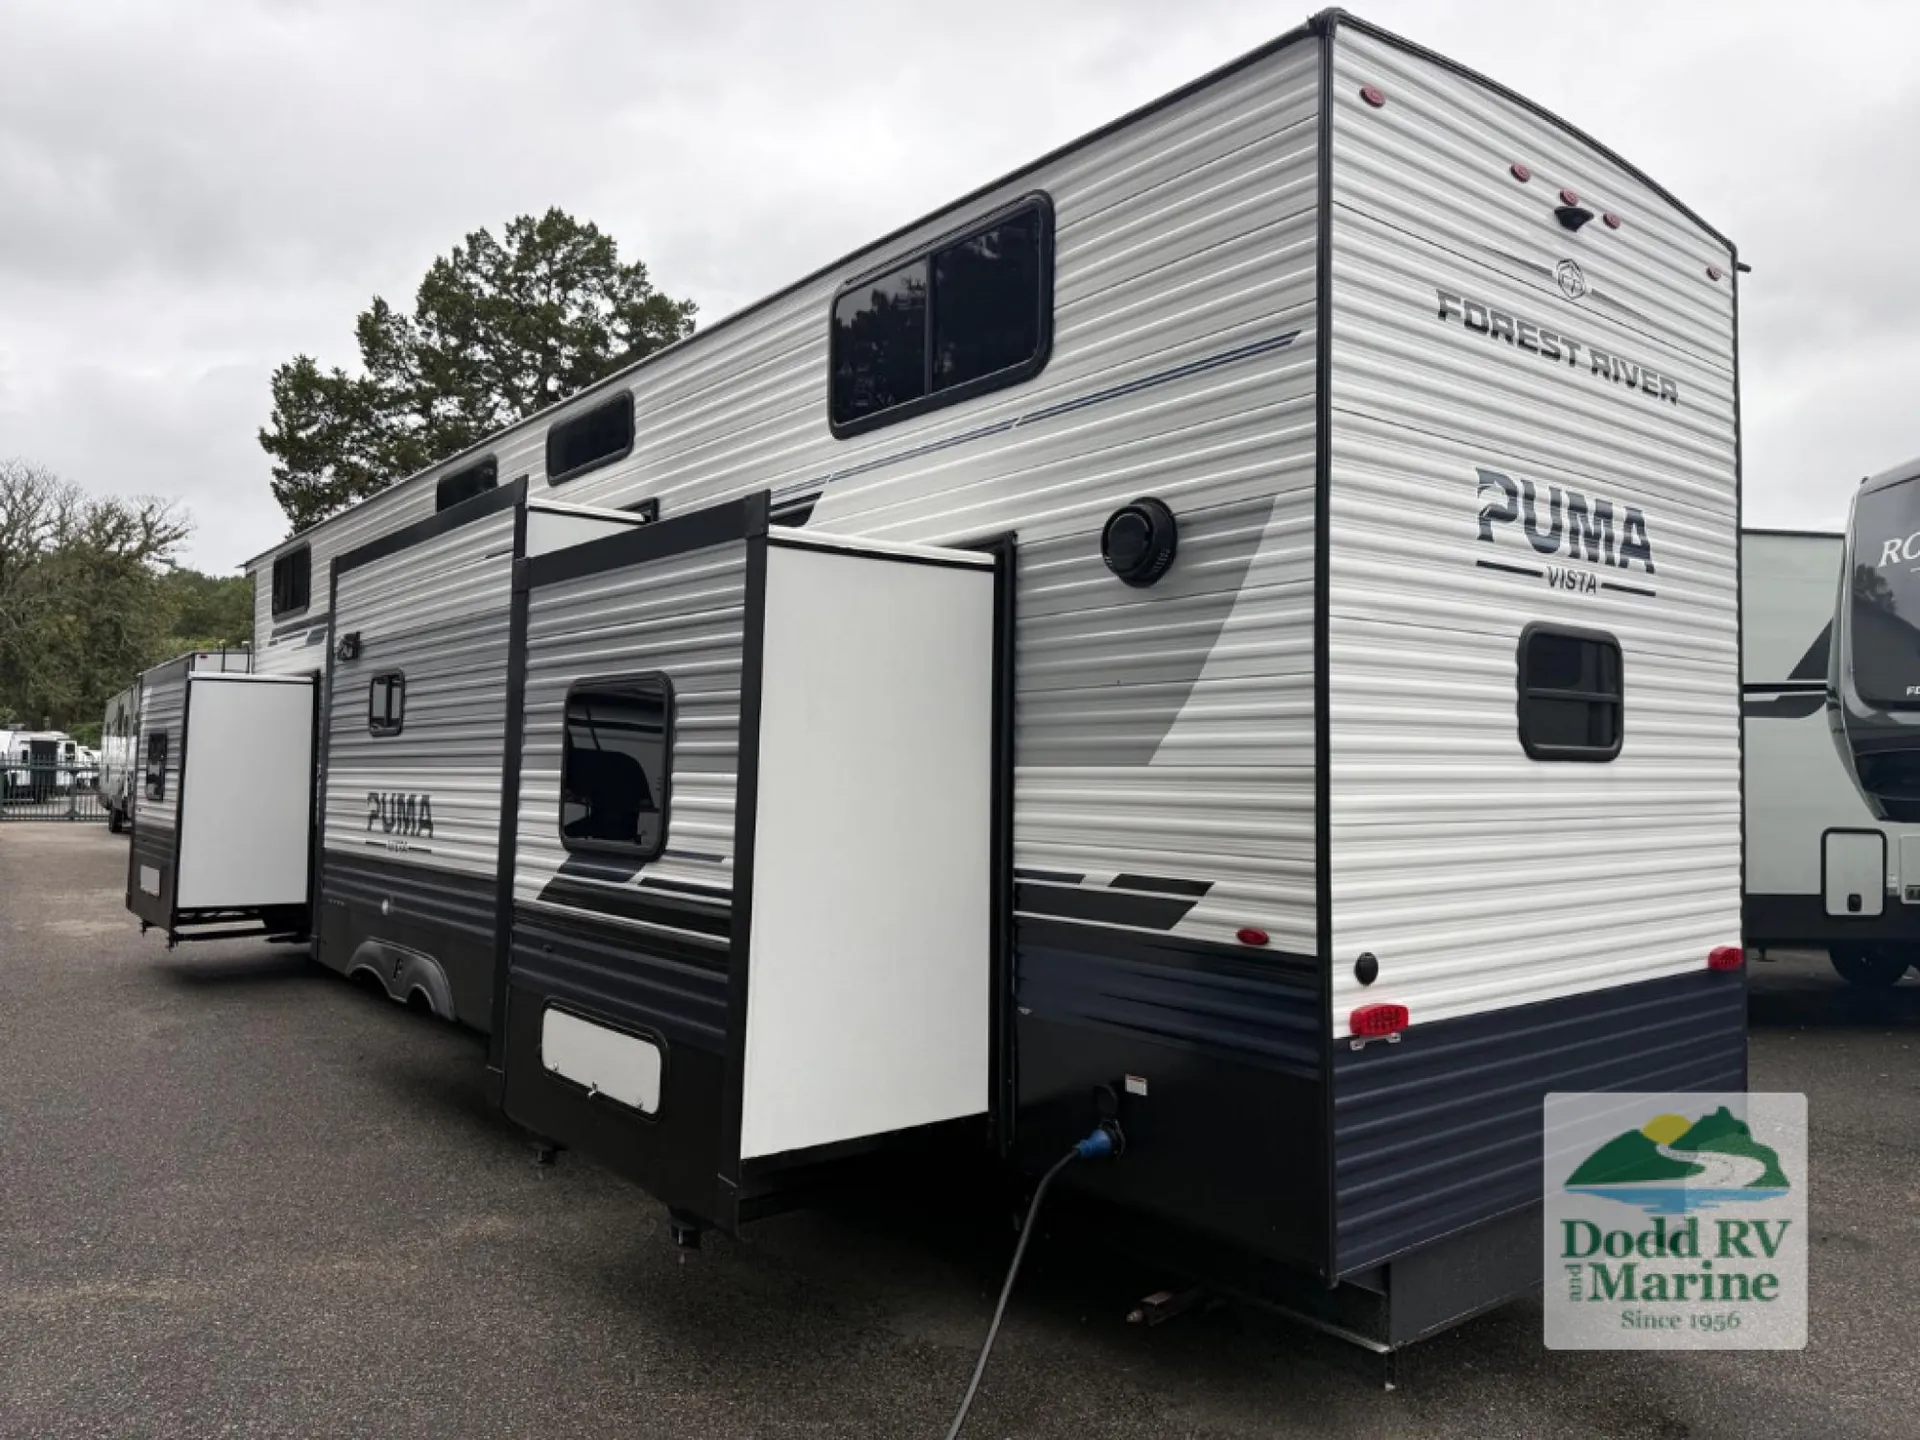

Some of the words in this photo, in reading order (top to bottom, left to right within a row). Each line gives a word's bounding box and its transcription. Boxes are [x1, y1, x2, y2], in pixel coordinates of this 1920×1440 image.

[1436, 288, 1582, 367] FOREST
[1588, 348, 1678, 405] RIVER
[1475, 467, 1656, 574] PUMA
[1547, 566, 1598, 594] VISTA
[367, 792, 433, 838] PUMA
